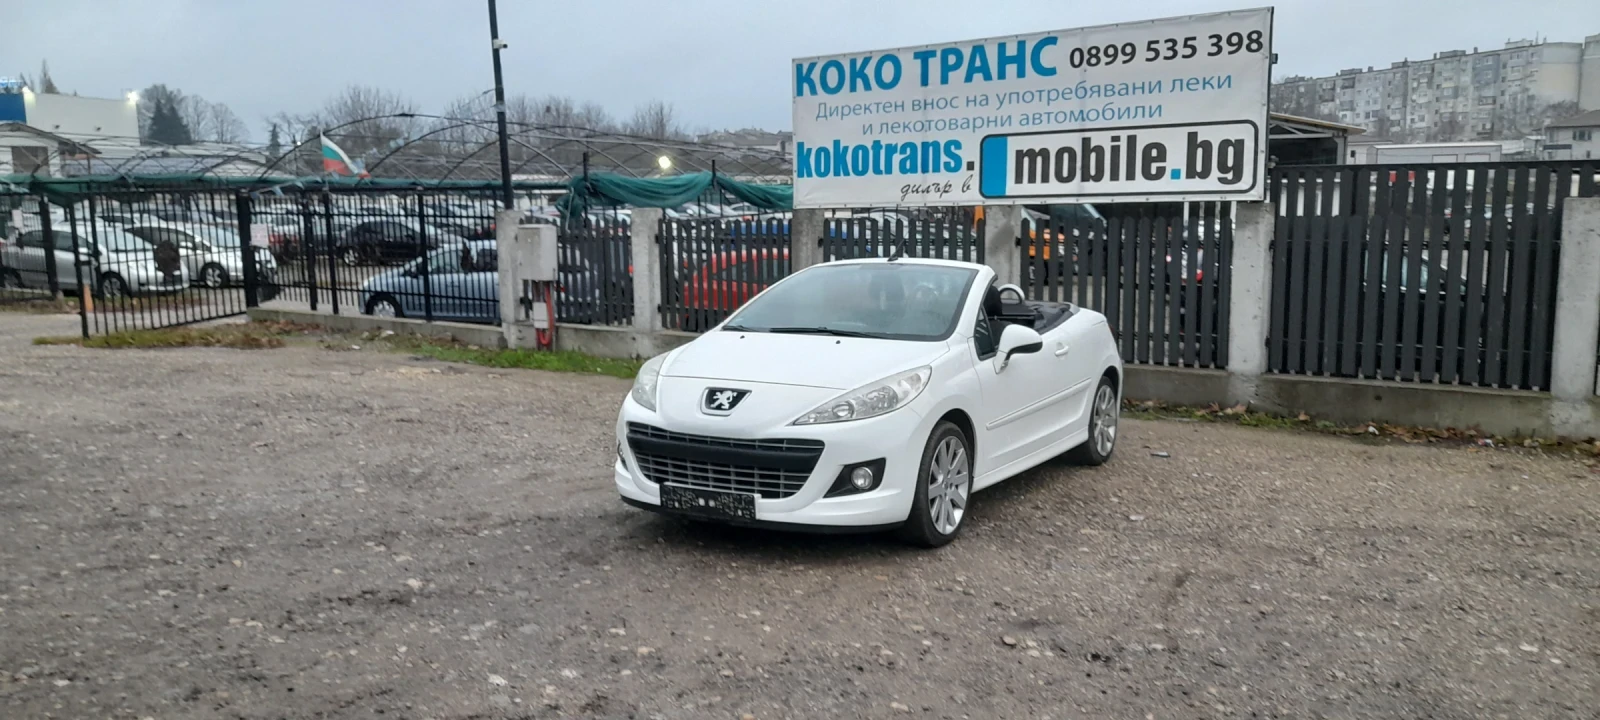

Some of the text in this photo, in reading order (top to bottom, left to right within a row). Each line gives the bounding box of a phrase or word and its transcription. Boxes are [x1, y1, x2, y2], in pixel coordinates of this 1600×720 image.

[795, 35, 1058, 97] КОКО ТРАНС
[1069, 30, 1263, 69] 0899 535 398
[815, 74, 1232, 122] Директен внос на употребявани леки
[862, 102, 1162, 136] и лекотоварни автомобили
[796, 131, 1245, 185] kokotrans. mobile.bg
[900, 174, 974, 201] дилър в
